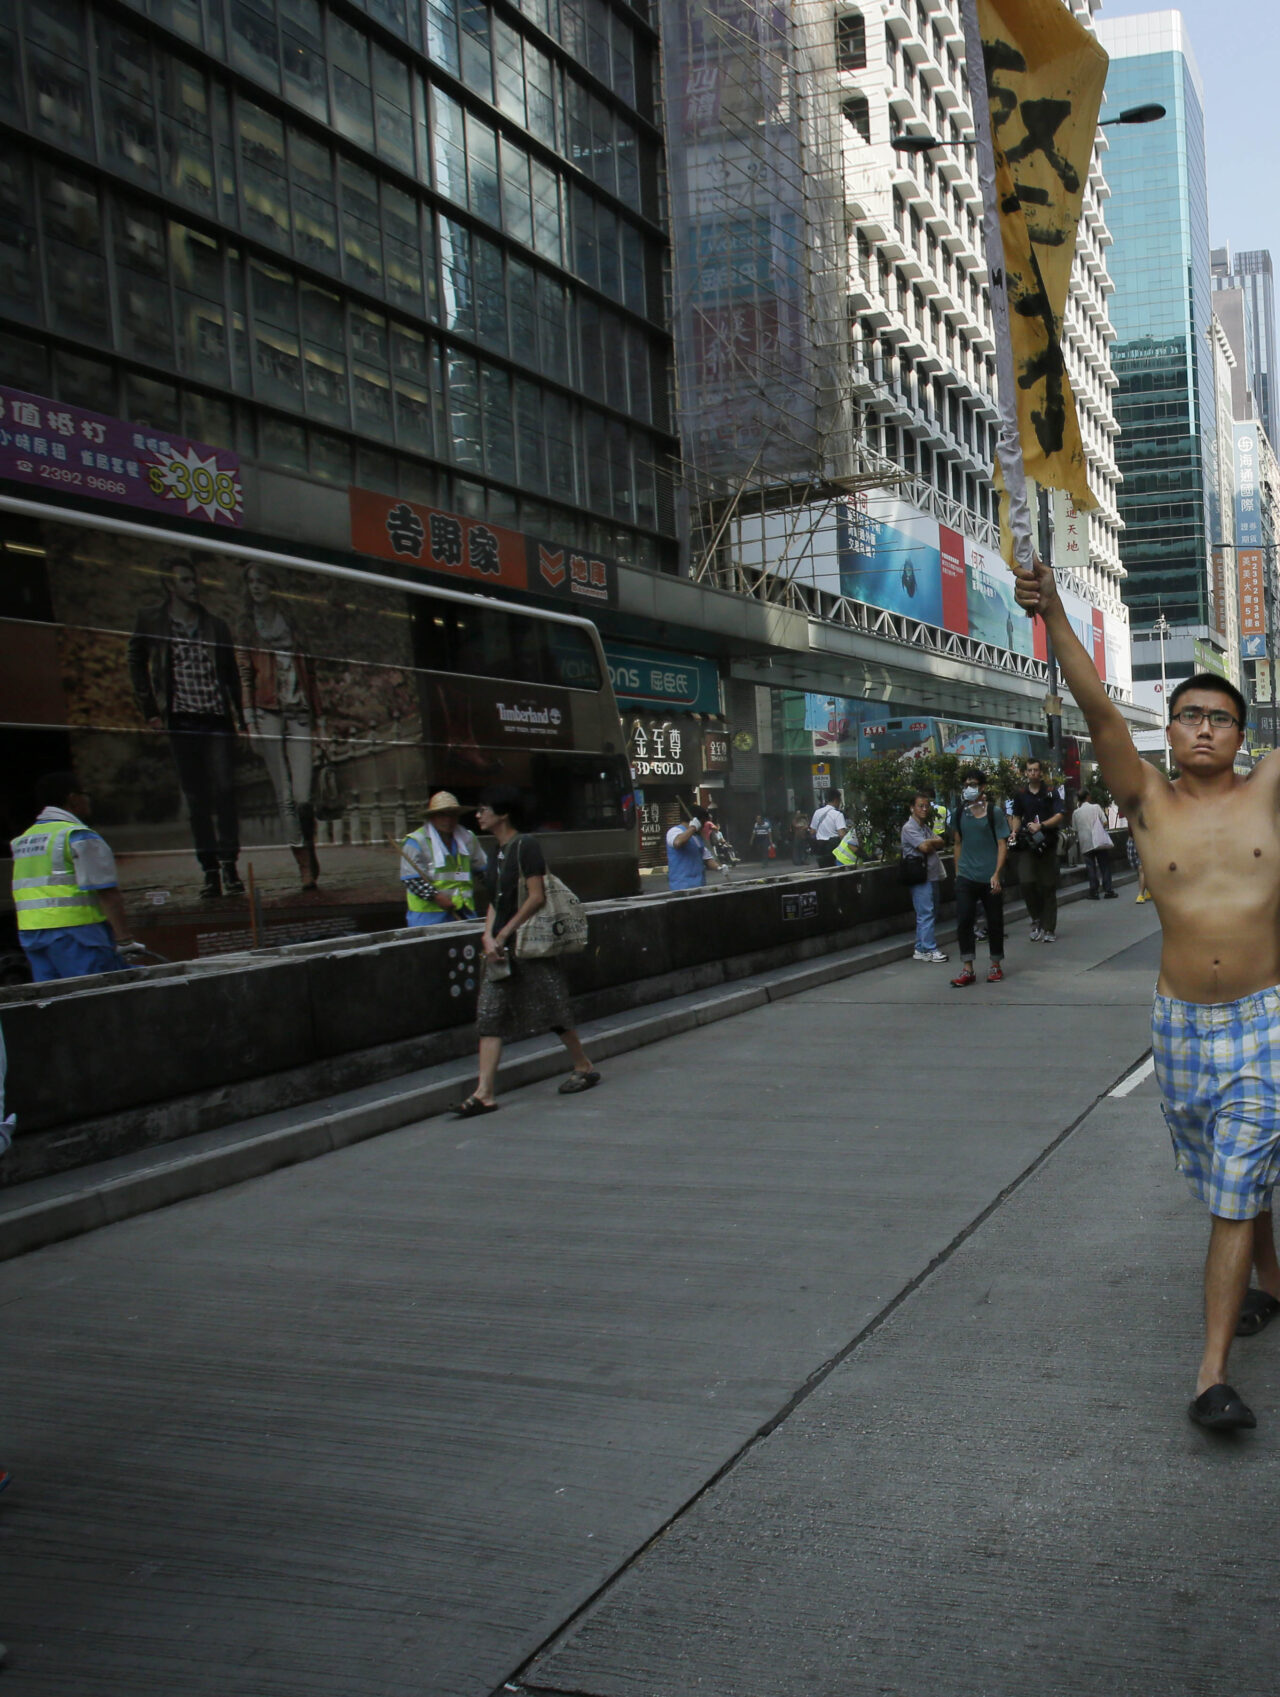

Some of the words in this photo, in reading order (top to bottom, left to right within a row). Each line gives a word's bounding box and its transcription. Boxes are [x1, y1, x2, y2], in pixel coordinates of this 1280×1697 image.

[0, 396, 107, 444] 值抵打
[40, 464, 82, 486] 2392
[149, 461, 237, 510] $398
[1239, 454, 1255, 513] 海通國際
[386, 503, 501, 576] 吉野家
[569, 553, 608, 587] 地庫
[650, 670, 688, 694] 屈臣氏
[496, 702, 549, 724] Timberland
[634, 726, 683, 759] 金至尊
